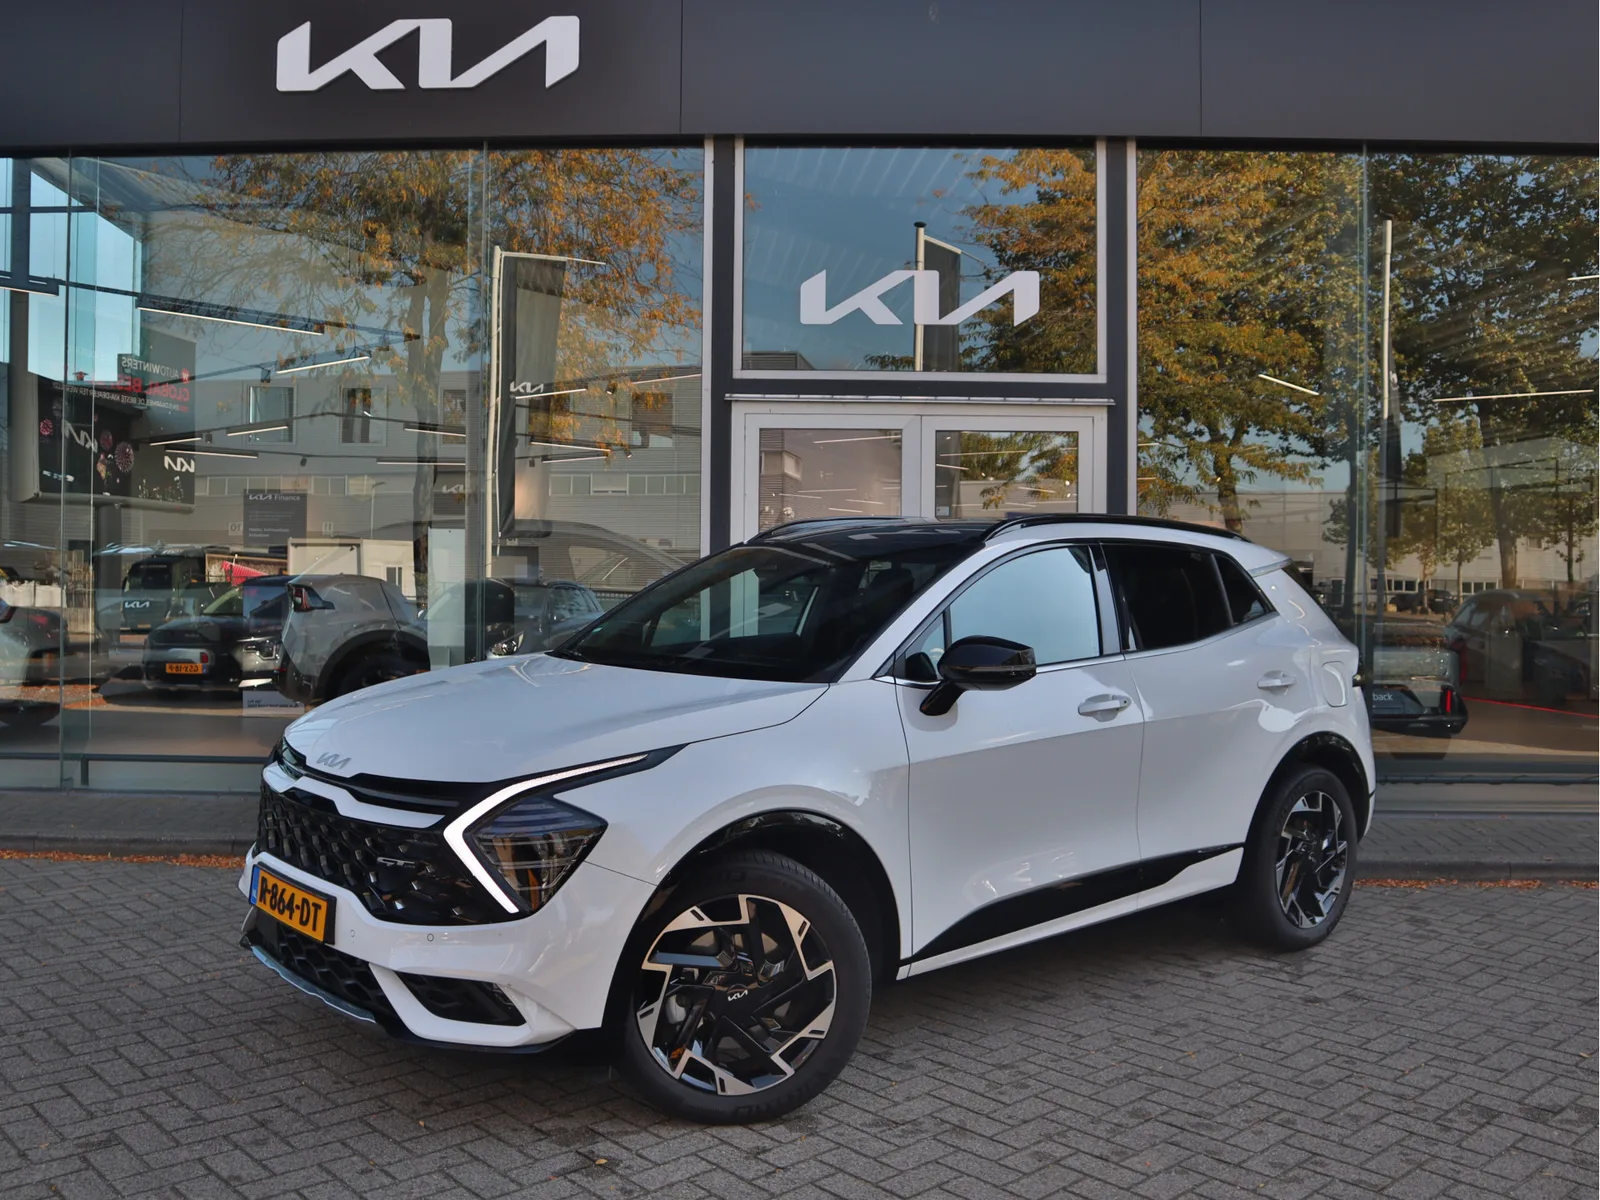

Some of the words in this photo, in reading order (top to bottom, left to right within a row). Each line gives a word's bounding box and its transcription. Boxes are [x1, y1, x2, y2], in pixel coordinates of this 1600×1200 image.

[276, 15, 580, 92] KIA
[800, 269, 1040, 327] KIA
[510, 381, 544, 394] KIA
[274, 494, 301, 502] Finance
[124, 600, 150, 609] KIA
[1373, 691, 1394, 701] back
[316, 752, 352, 769] KIA
[259, 876, 322, 932] R-864-DT
[728, 990, 749, 1001] KIA
